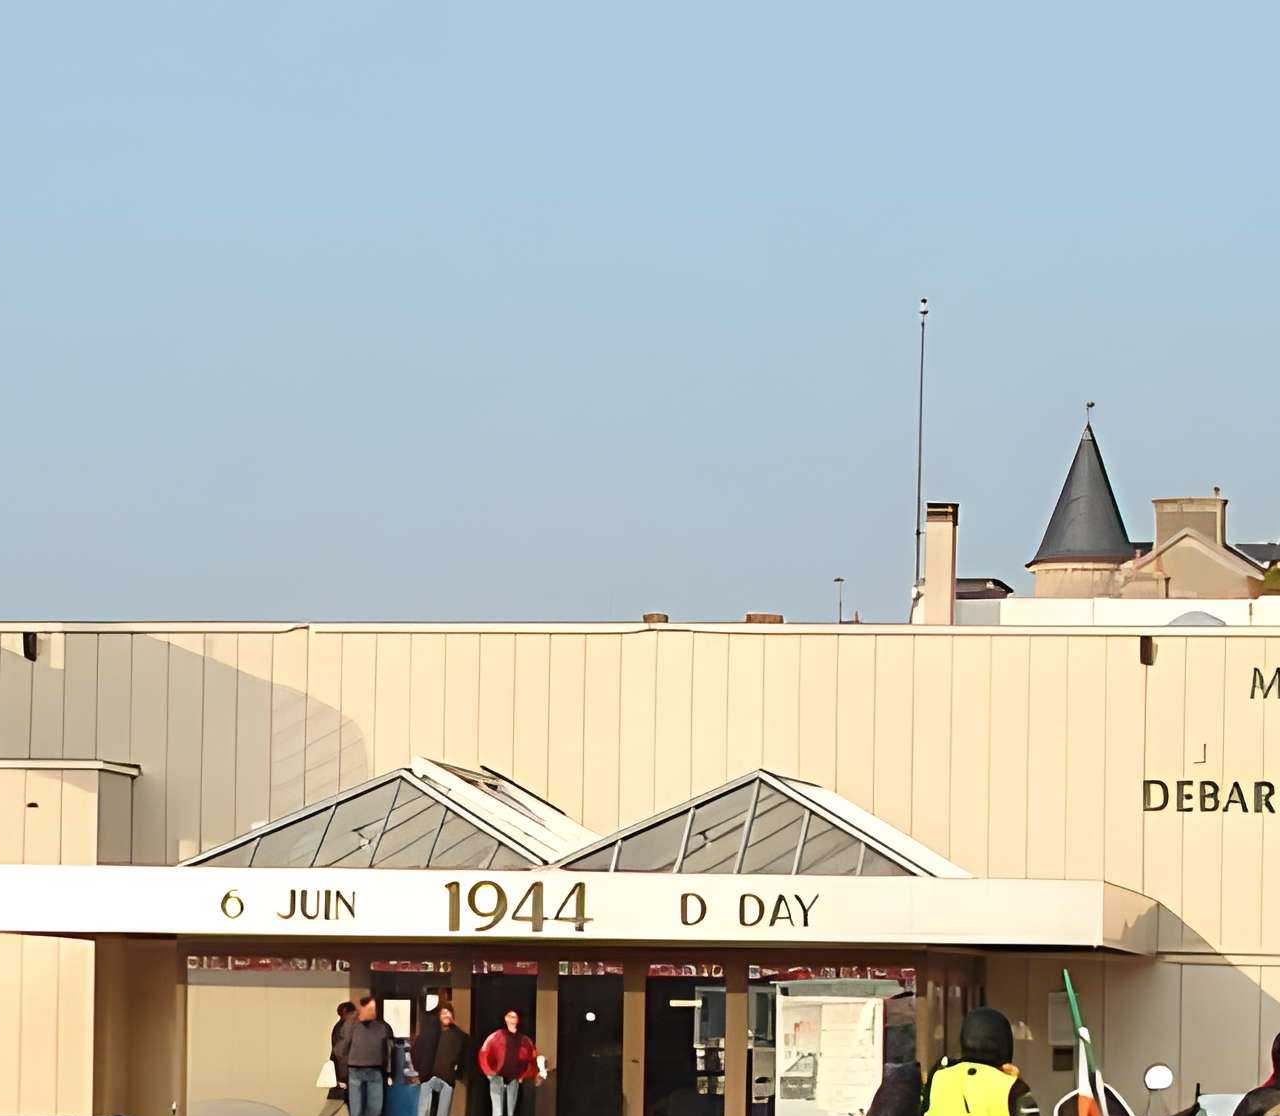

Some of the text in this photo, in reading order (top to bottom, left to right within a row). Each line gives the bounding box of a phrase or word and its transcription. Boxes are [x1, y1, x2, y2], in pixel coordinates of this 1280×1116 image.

[220, 880, 820, 932] 6 JUIN 1944 D DAY
